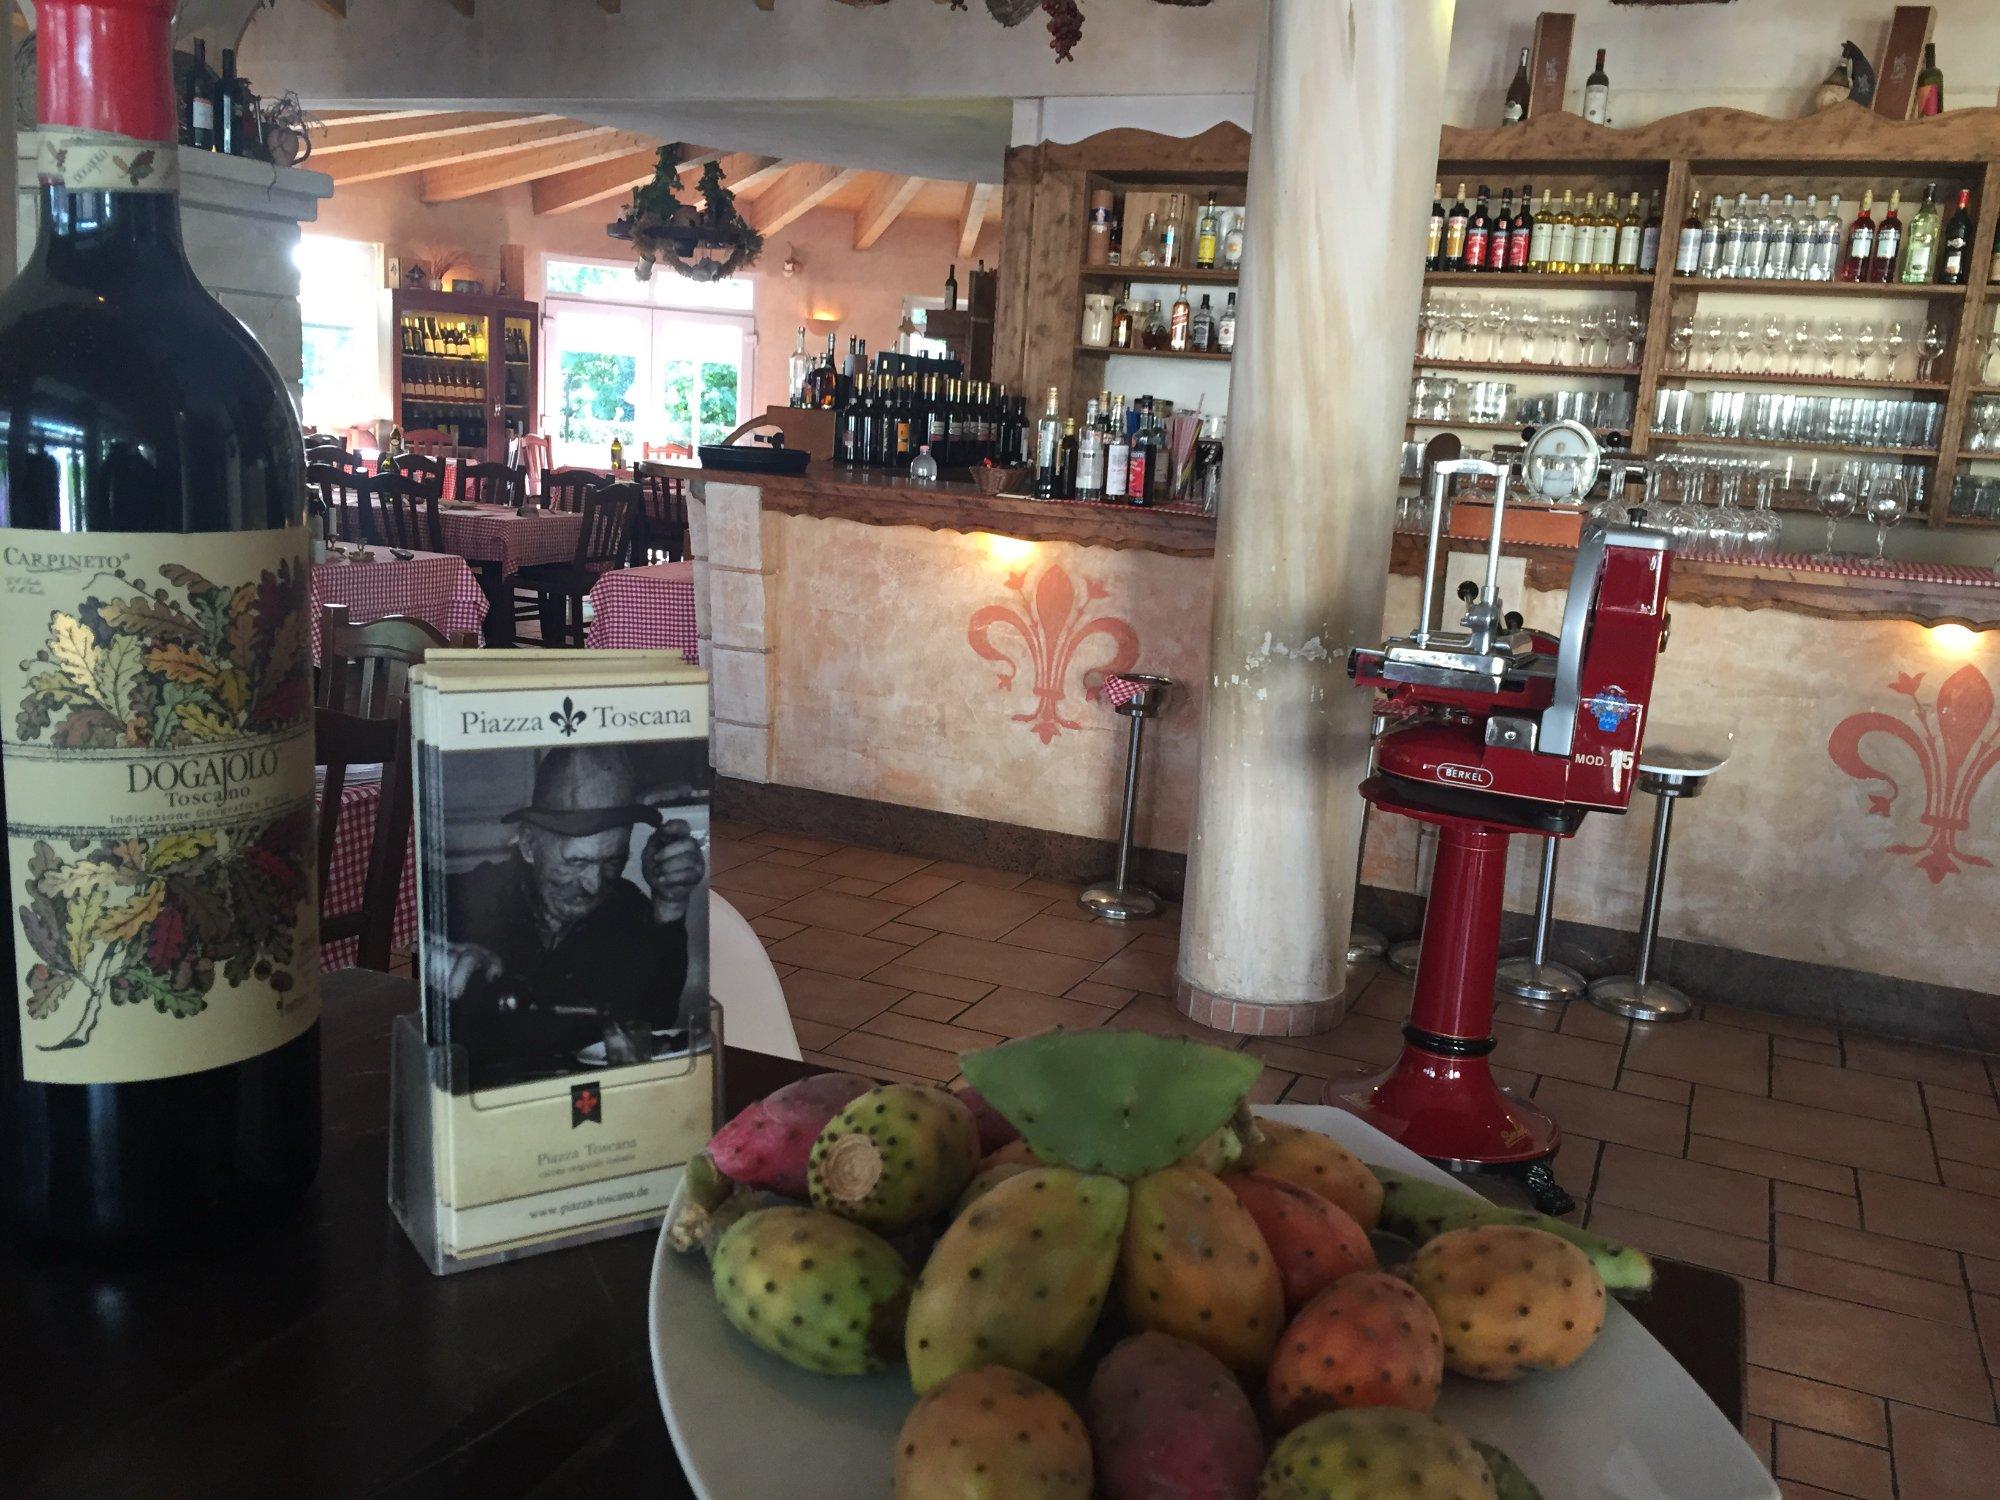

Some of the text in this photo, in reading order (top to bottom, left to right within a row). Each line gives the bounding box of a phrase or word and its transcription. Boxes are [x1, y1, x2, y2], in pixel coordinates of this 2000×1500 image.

[460, 705, 692, 735] Piazza Toscana
[1574, 753, 1607, 768] MOD.
[127, 747, 278, 807] DOGAJOLO
[1445, 768, 1483, 782] BERKEL
[164, 787, 251, 808] Toscano
[537, 1150, 580, 1167] Piazza
[584, 1138, 638, 1156] Toscana
